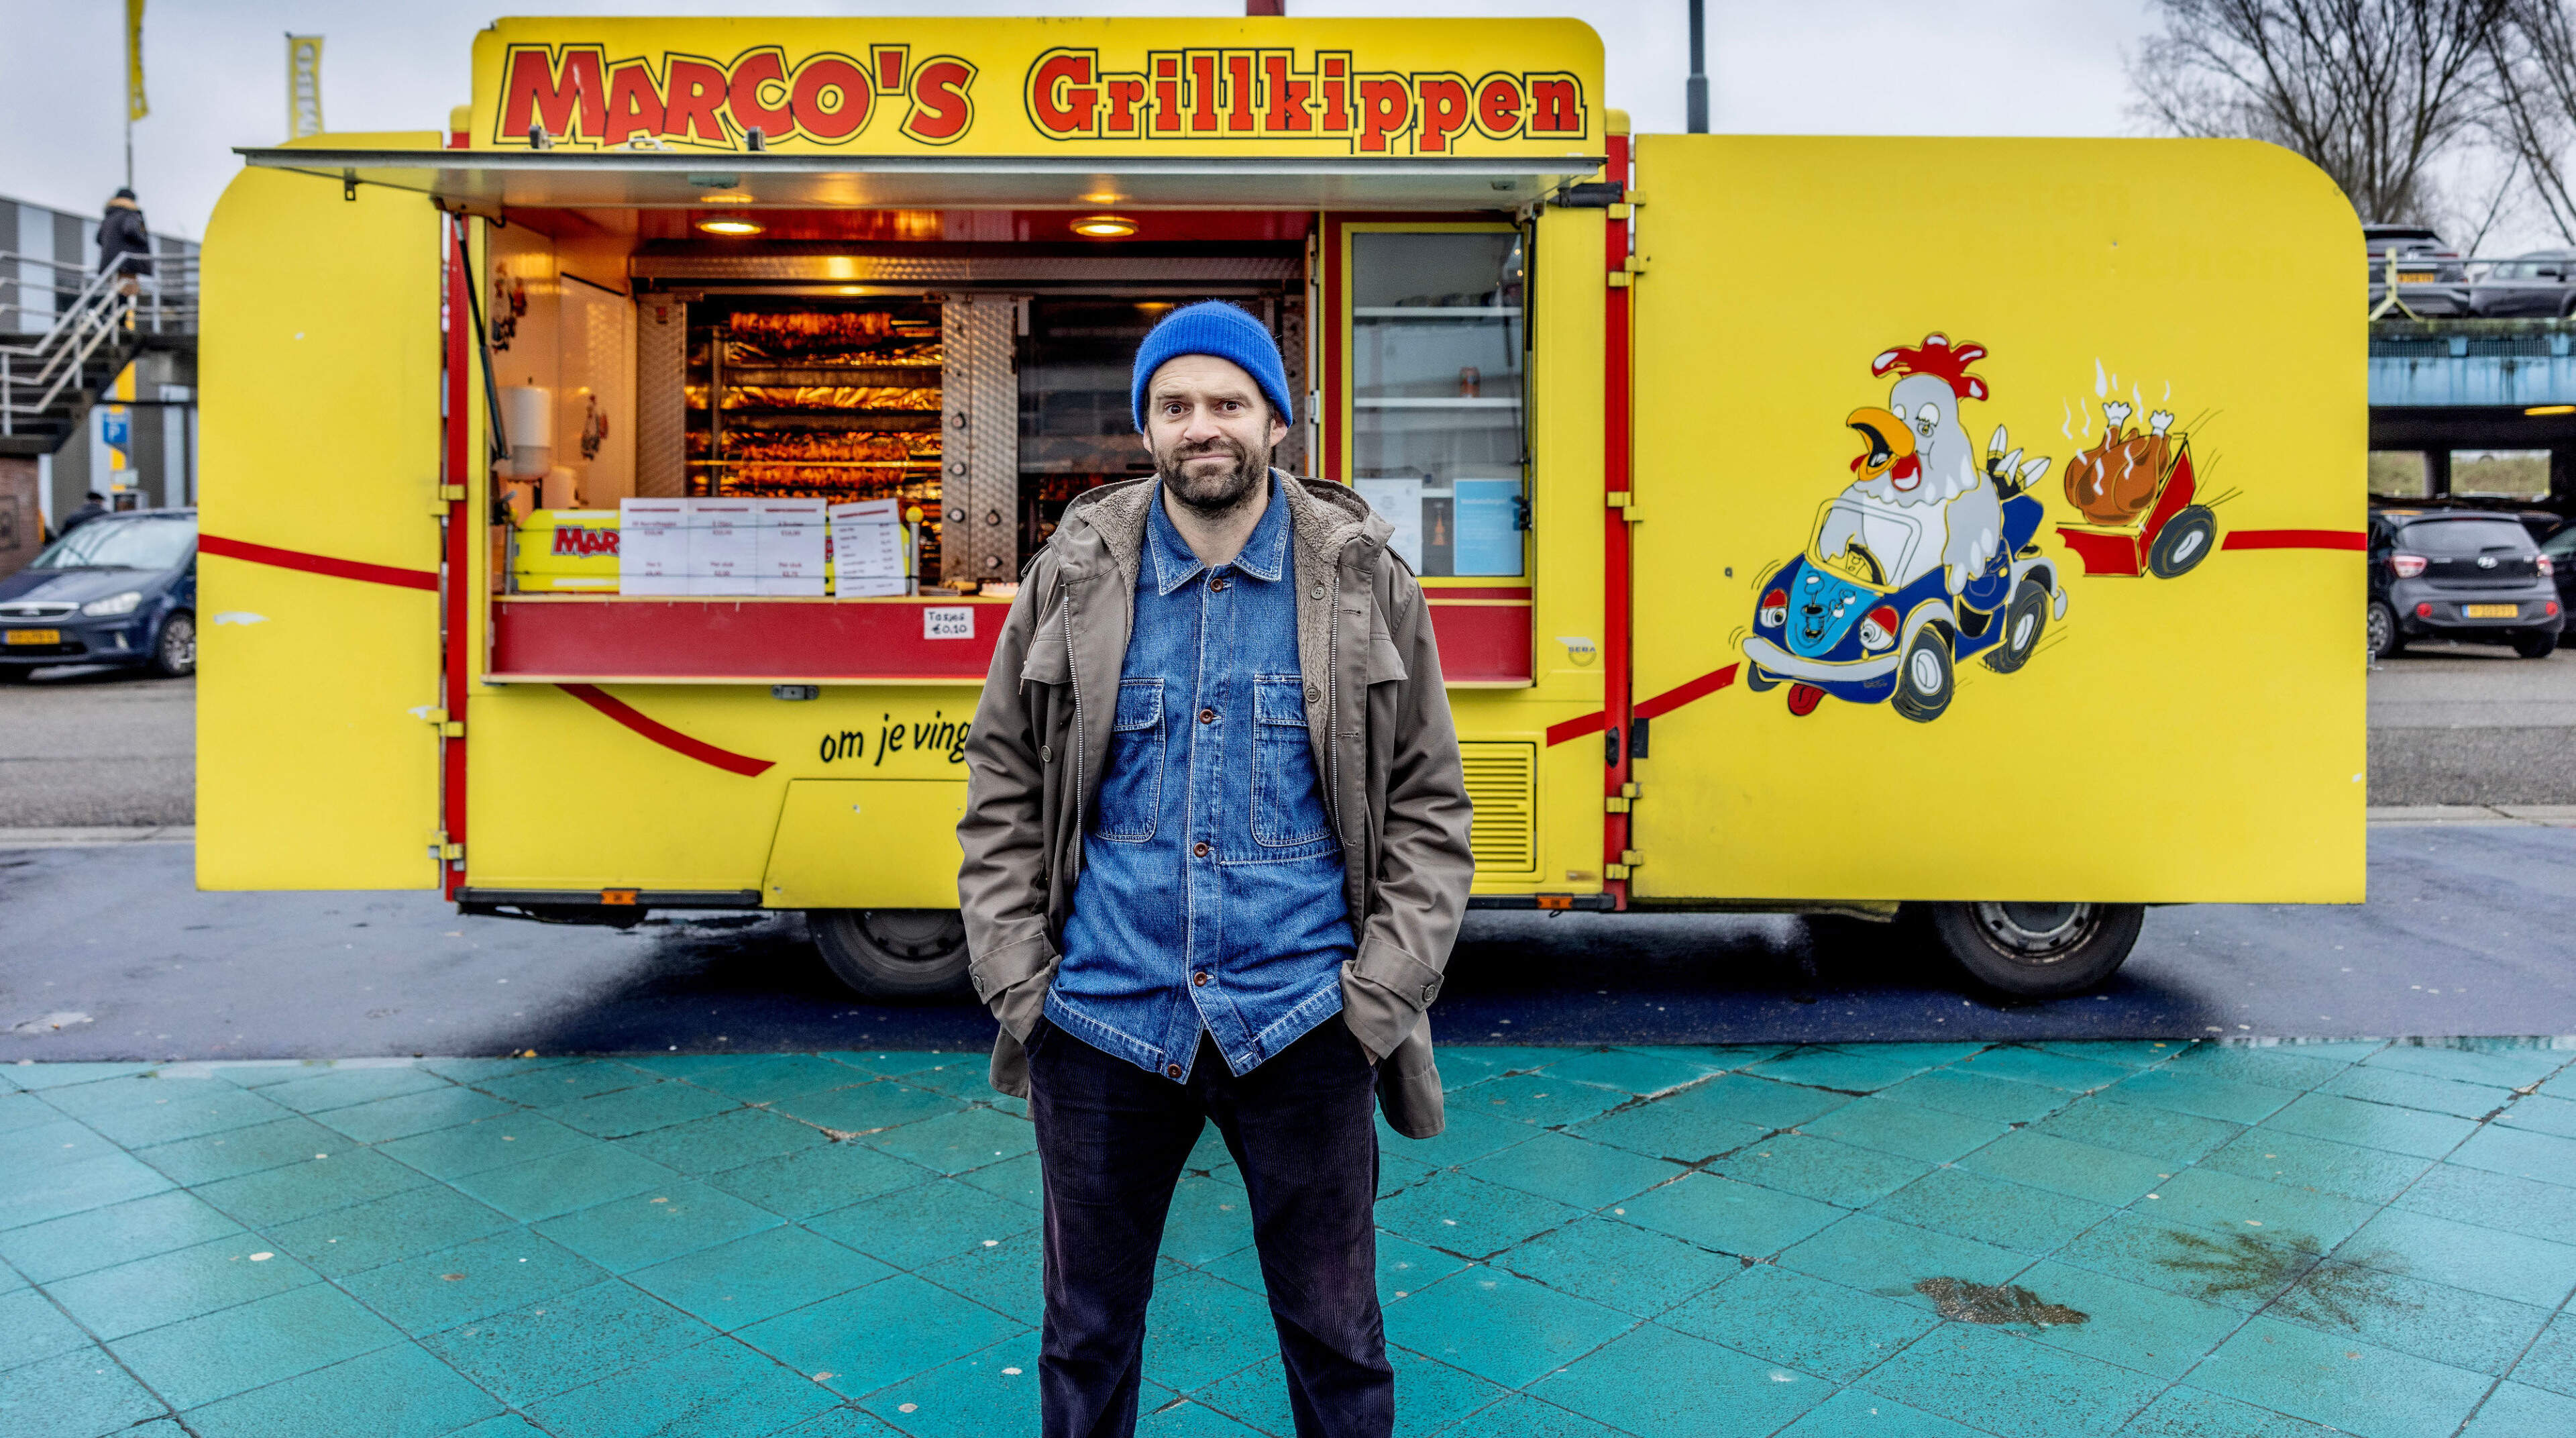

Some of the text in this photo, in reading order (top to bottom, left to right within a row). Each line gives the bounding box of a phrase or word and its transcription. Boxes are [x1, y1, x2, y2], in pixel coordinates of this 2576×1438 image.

[297, 42, 318, 137] MBO
[494, 44, 1587, 155] MARCO'S Grillkippen
[820, 731, 863, 763] om
[873, 713, 905, 766] je
